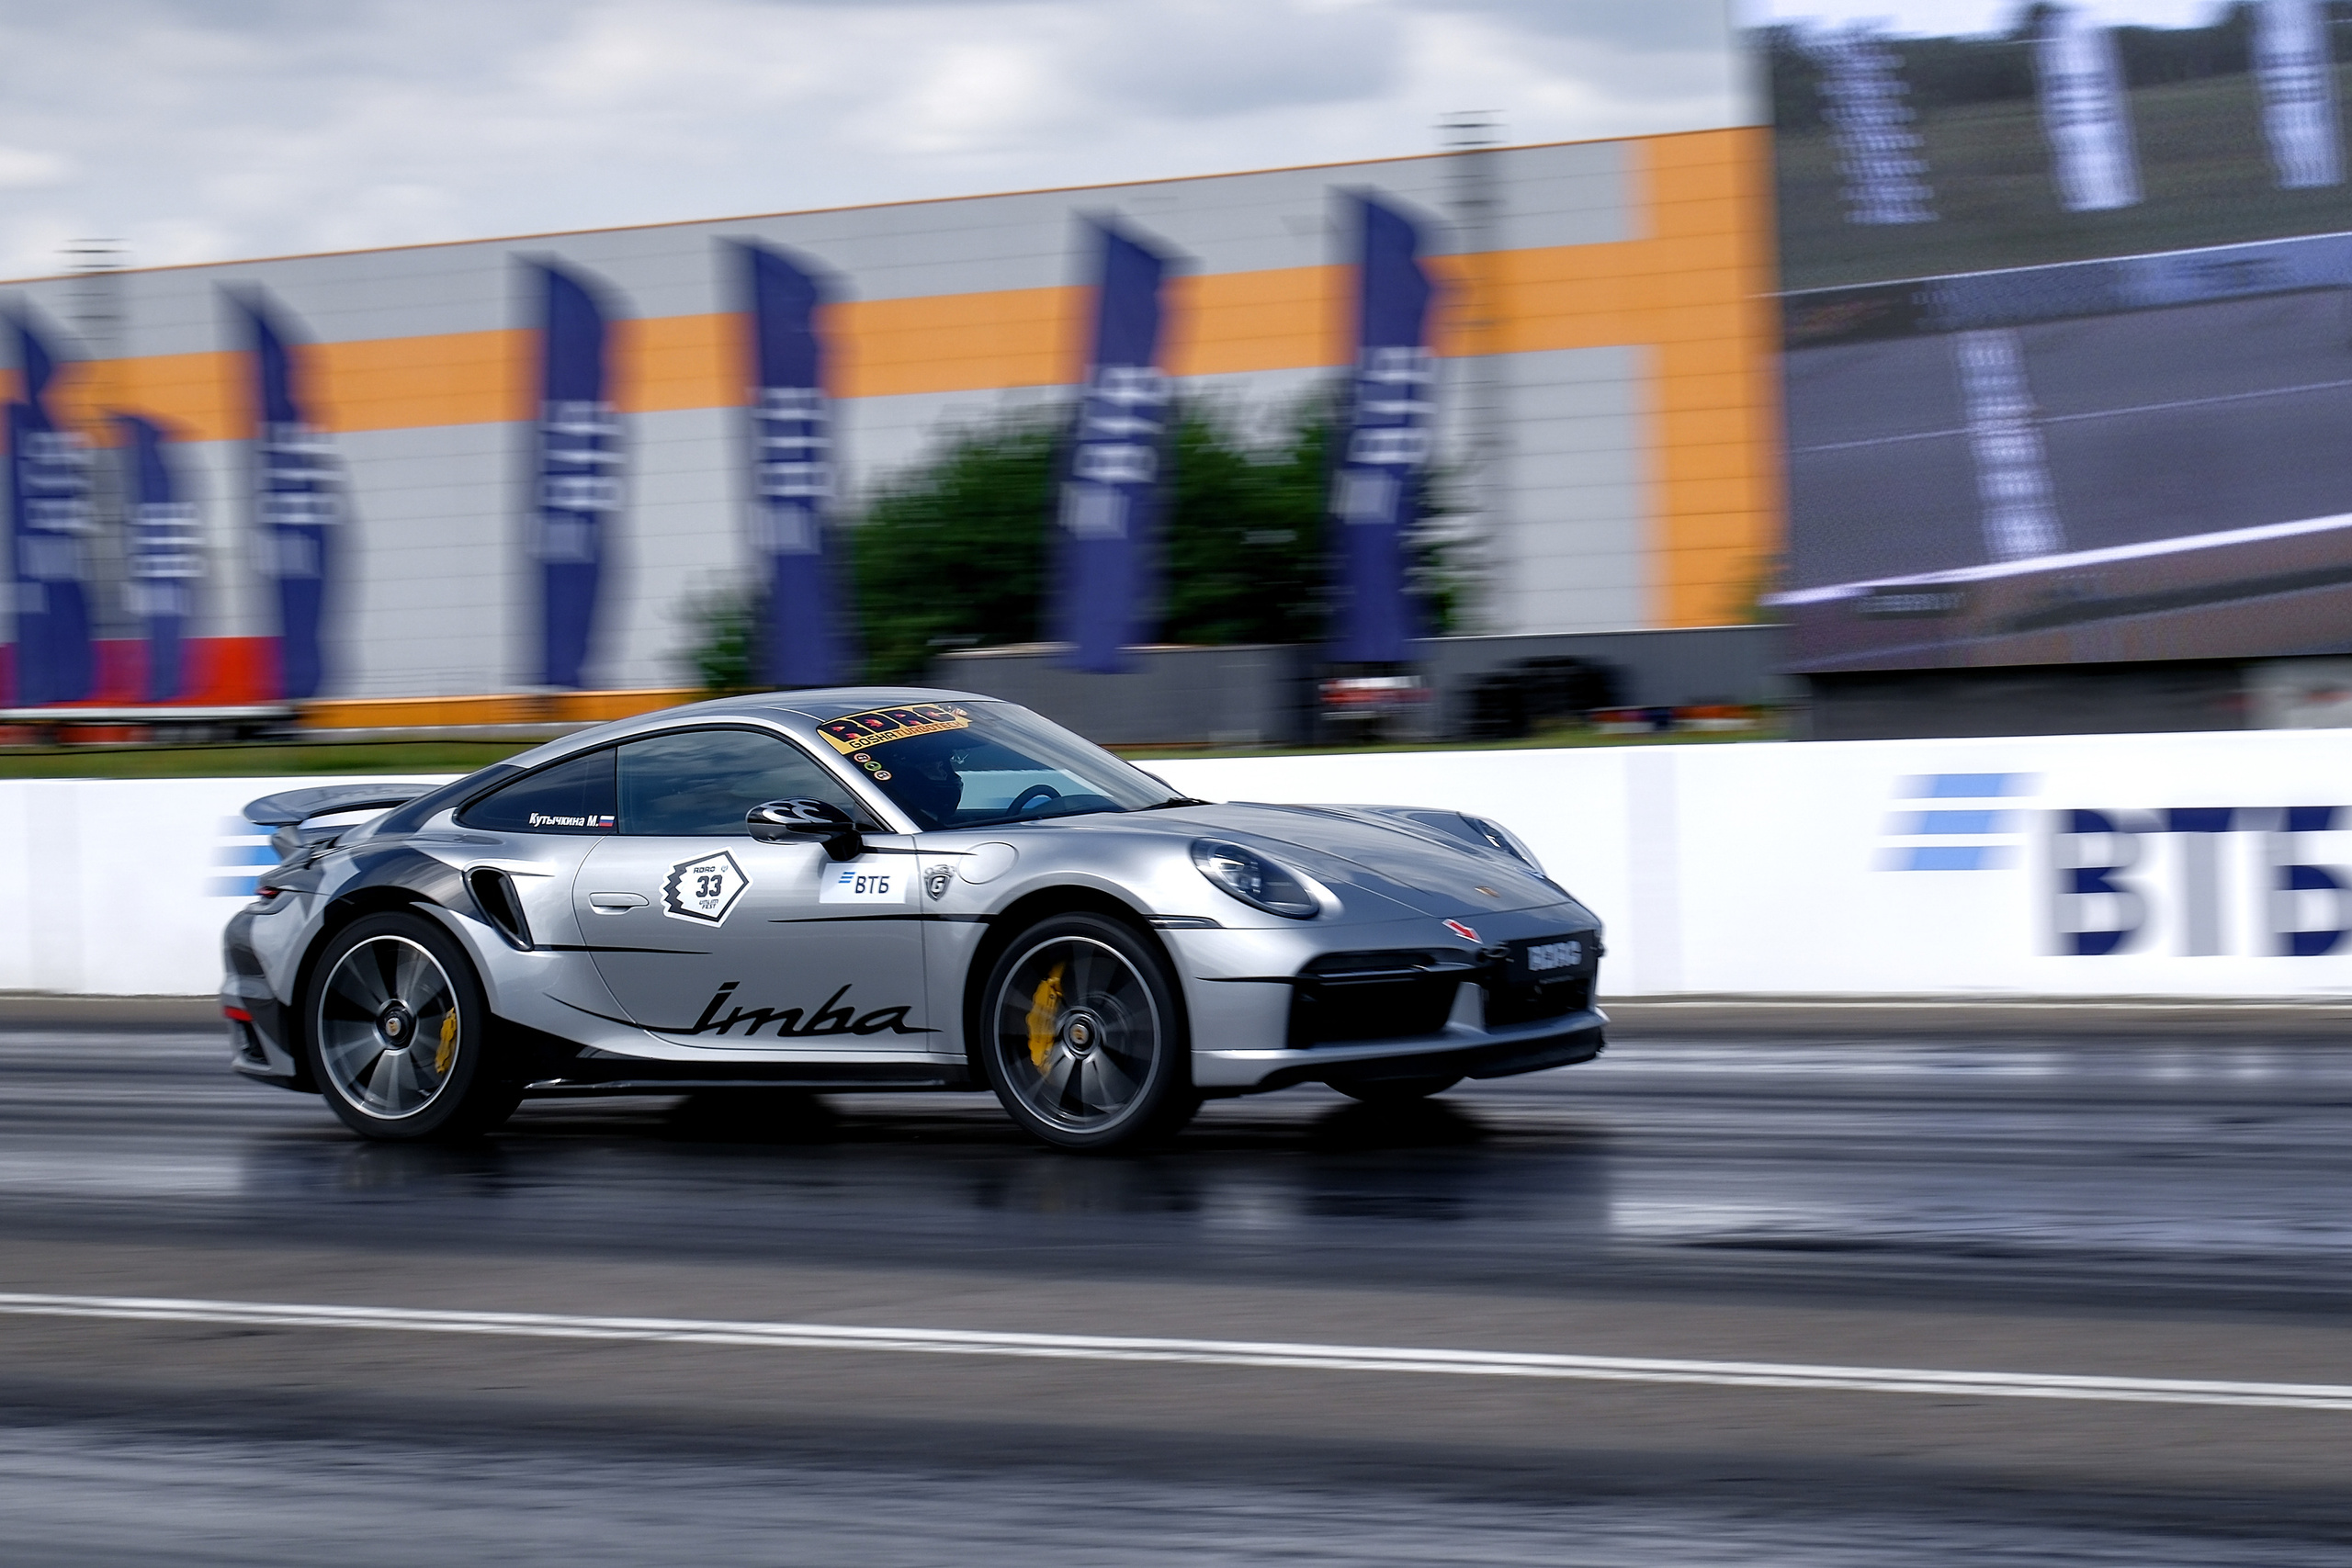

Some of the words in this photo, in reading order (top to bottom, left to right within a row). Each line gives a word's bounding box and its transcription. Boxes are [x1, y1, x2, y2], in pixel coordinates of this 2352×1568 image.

[528, 812, 585, 828] Кутычкина
[695, 874, 722, 897] 33
[854, 875, 890, 894] ВТБ
[2041, 805, 2352, 957] ВТБ
[680, 981, 943, 1036] imba
